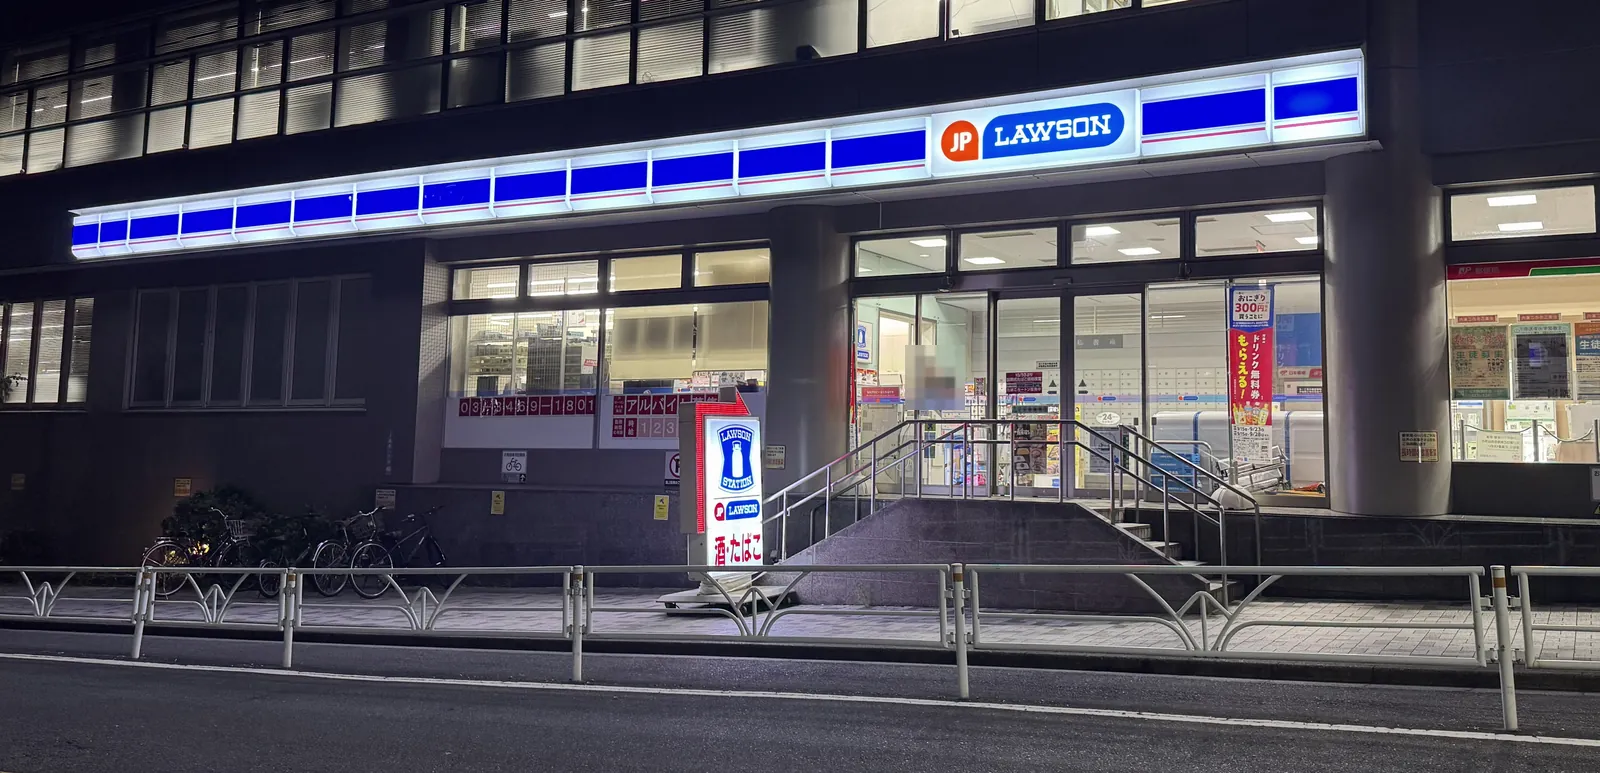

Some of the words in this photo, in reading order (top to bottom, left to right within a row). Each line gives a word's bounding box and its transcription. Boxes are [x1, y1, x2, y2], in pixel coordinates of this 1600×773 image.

[950, 132, 972, 152] JP
[994, 114, 1111, 146] LAWSON
[1238, 294, 1266, 302] おにぎり
[1235, 303, 1265, 313] 300円
[1251, 334, 1260, 399] ドリンク無料券
[721, 429, 752, 442] LAWSON
[722, 476, 752, 489] STATION
[728, 504, 758, 515] LAWSON
